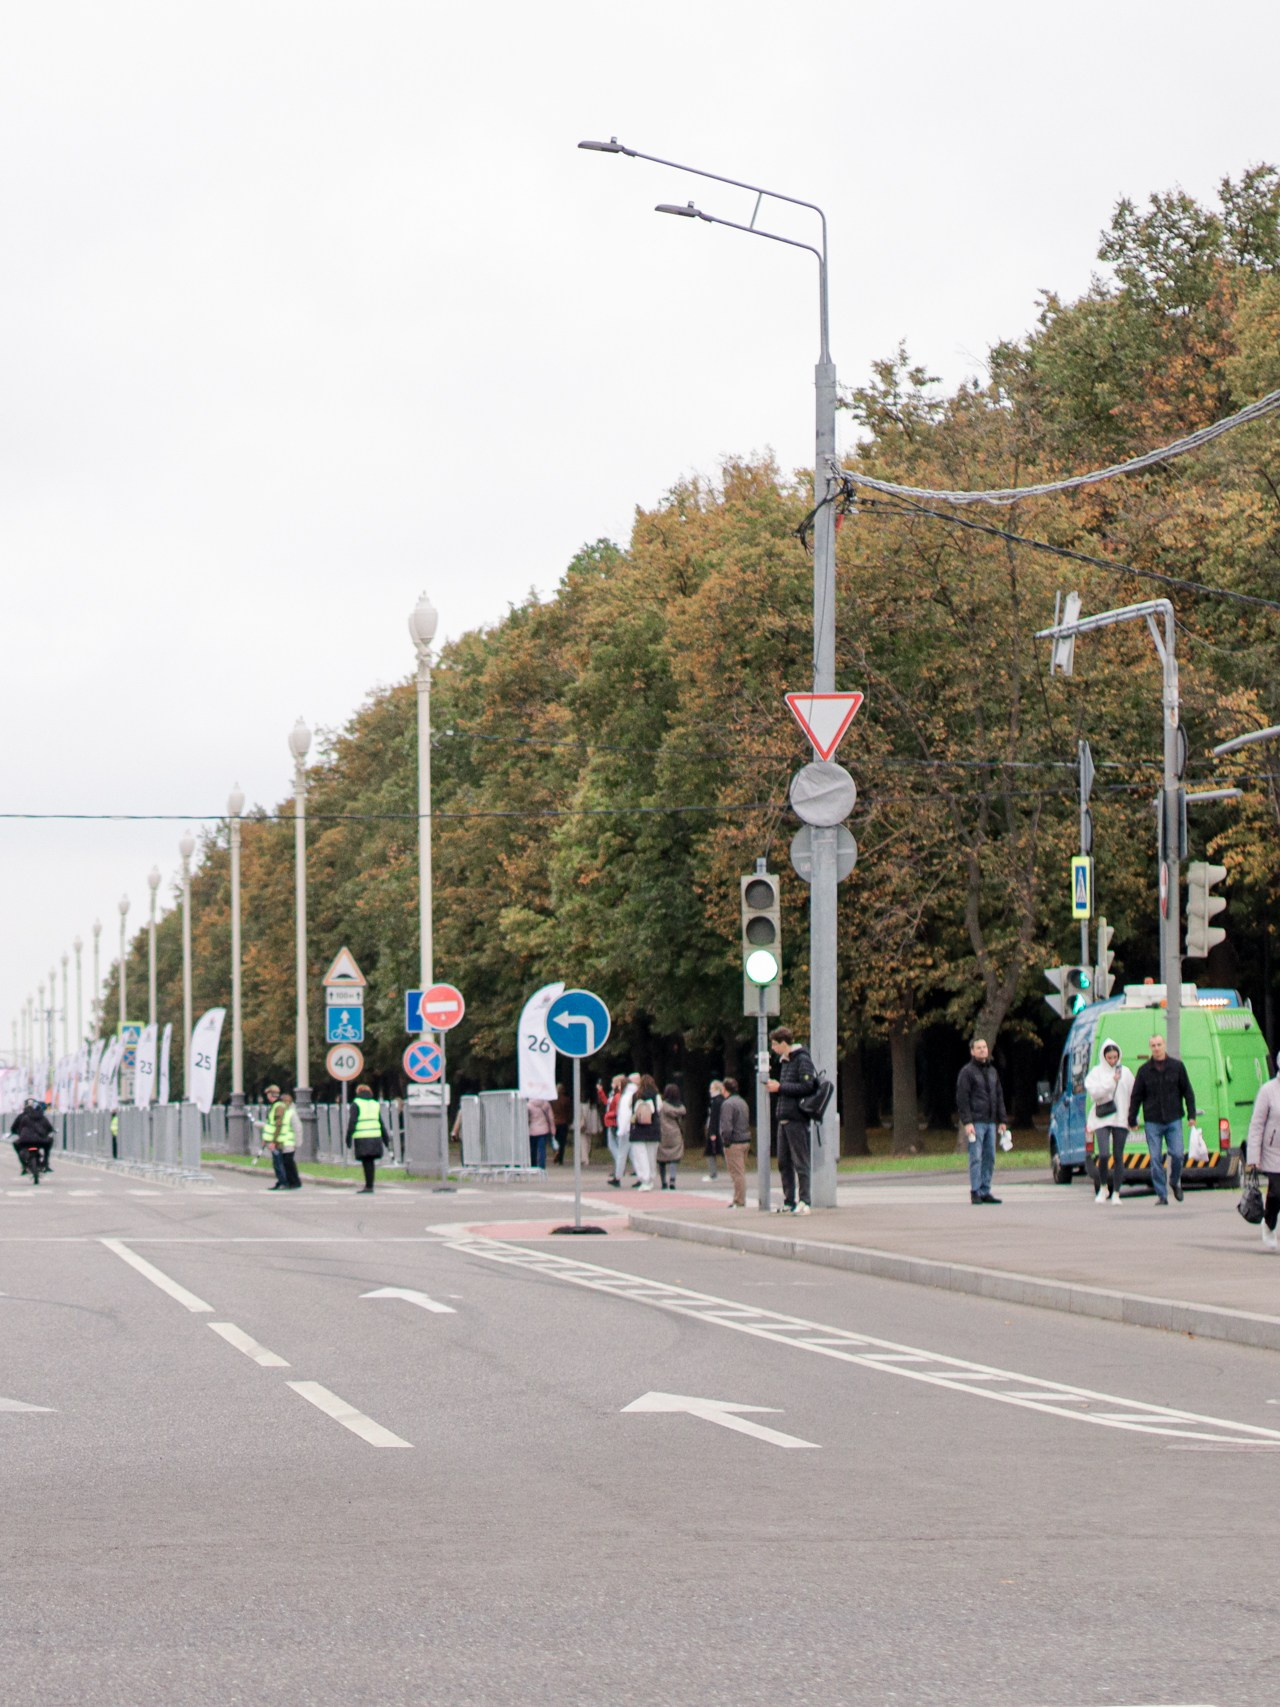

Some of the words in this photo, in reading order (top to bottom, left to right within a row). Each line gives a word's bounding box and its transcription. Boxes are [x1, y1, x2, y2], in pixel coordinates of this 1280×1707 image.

[527, 1035, 550, 1054] 26
[140, 1060, 152, 1075] 23
[195, 1053, 211, 1071] 25
[334, 1056, 356, 1069] 40
